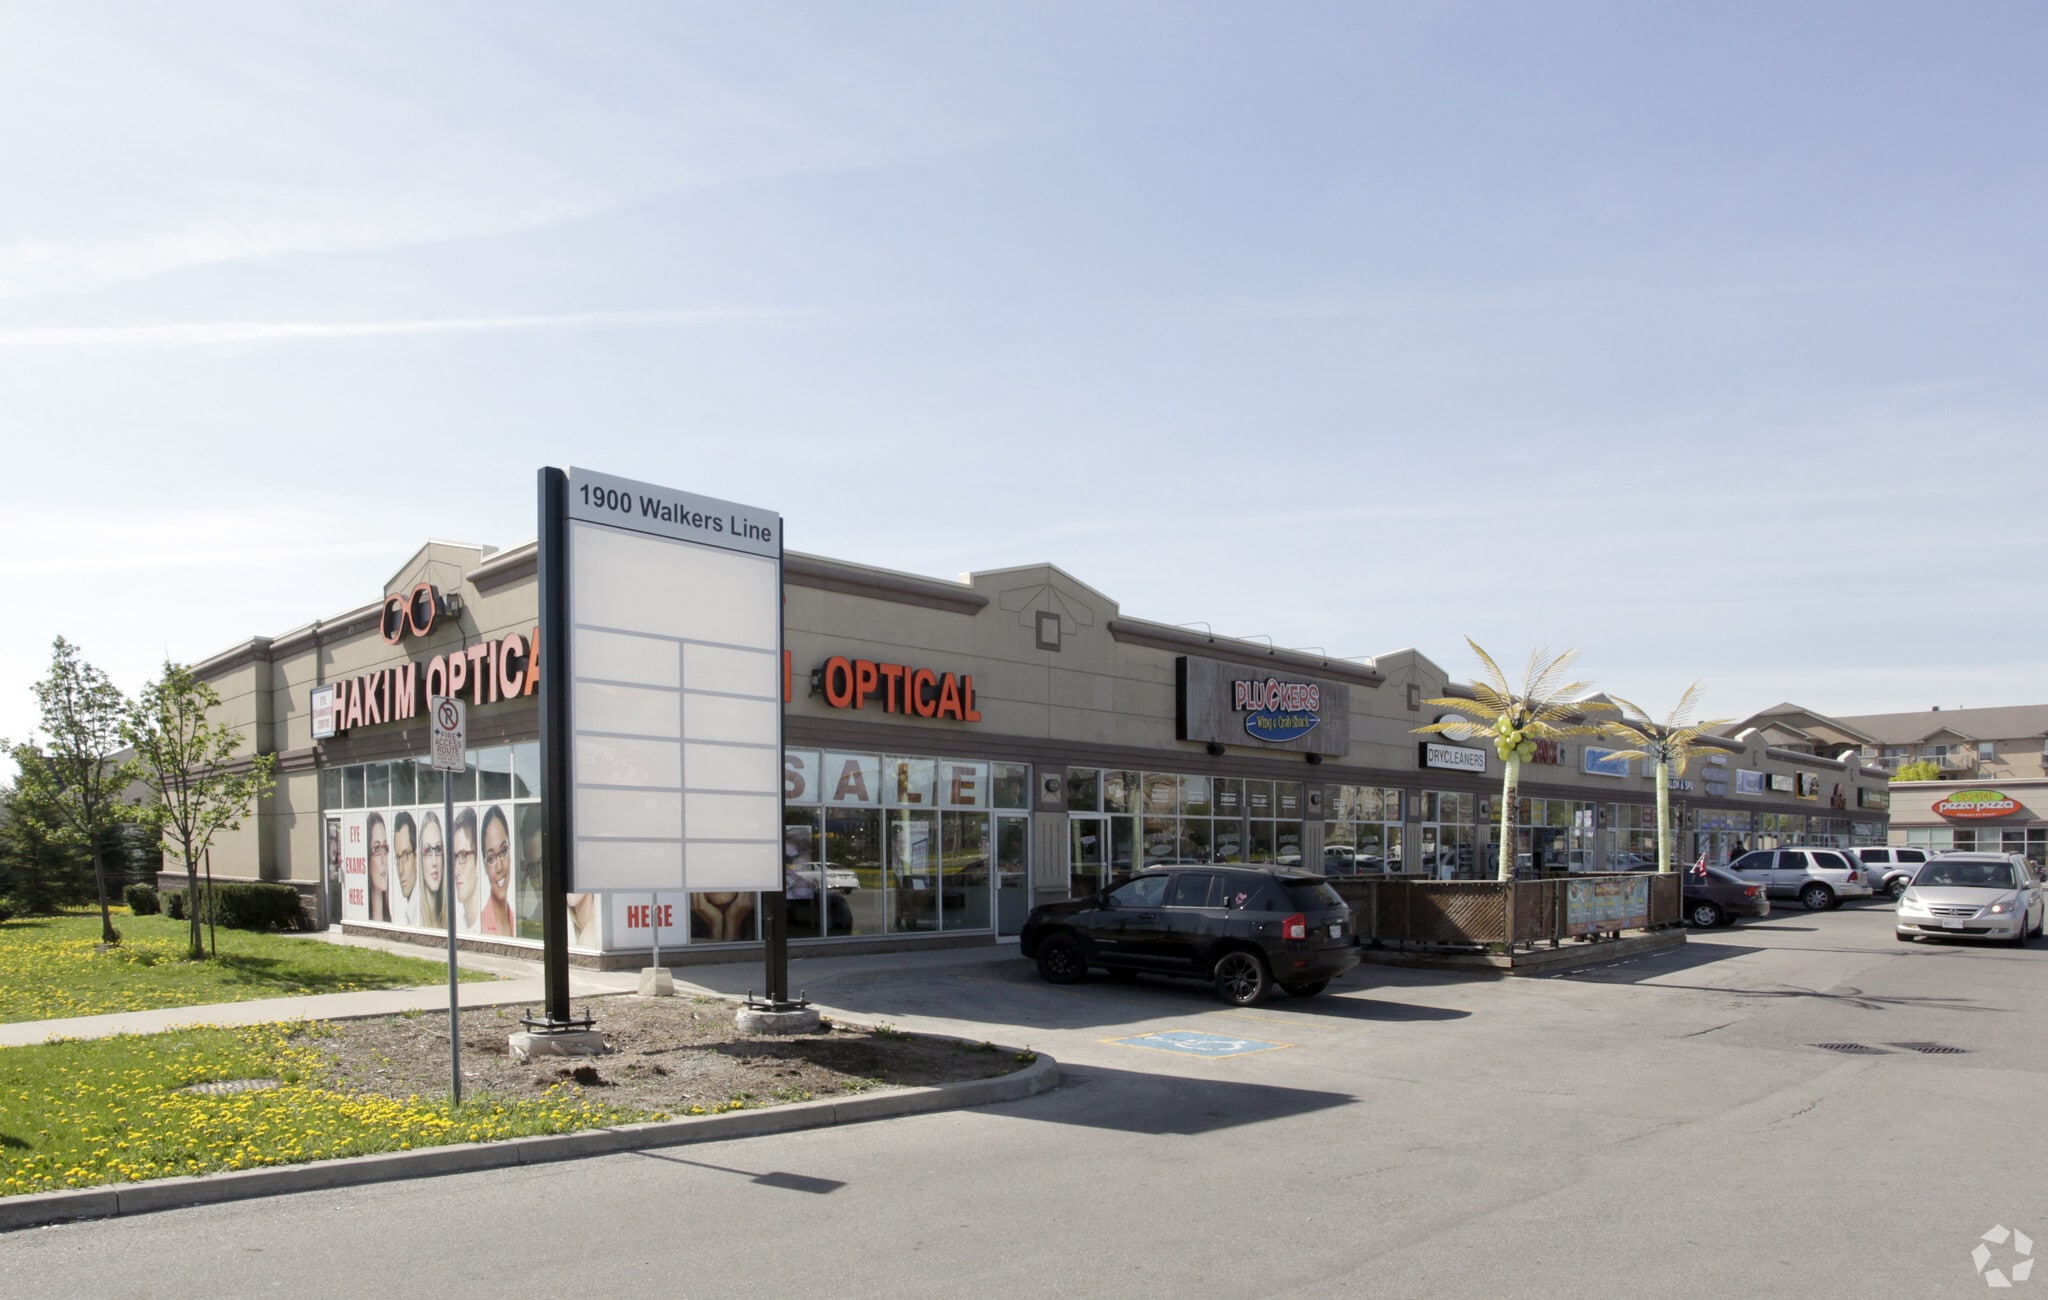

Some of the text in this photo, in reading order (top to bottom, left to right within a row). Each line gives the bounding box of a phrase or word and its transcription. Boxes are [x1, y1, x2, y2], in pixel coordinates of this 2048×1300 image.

[580, 483, 772, 543] 1900 Walkers Line
[332, 626, 540, 732] HAKIM OPTICA
[824, 655, 982, 723] OPTICAL
[1235, 678, 1320, 712] PLUCKERS
[435, 739, 462, 749] ACCESS
[440, 731, 457, 740] FIRE
[437, 746, 459, 756] ROUTE
[1428, 748, 1484, 768] DRYCLEANERS
[785, 754, 977, 806] SALE
[1939, 799, 2014, 813] pizza pizza
[350, 825, 361, 843] EYE
[345, 856, 367, 875] EXAMS
[348, 887, 364, 906] HERE
[627, 904, 673, 928] HERE
